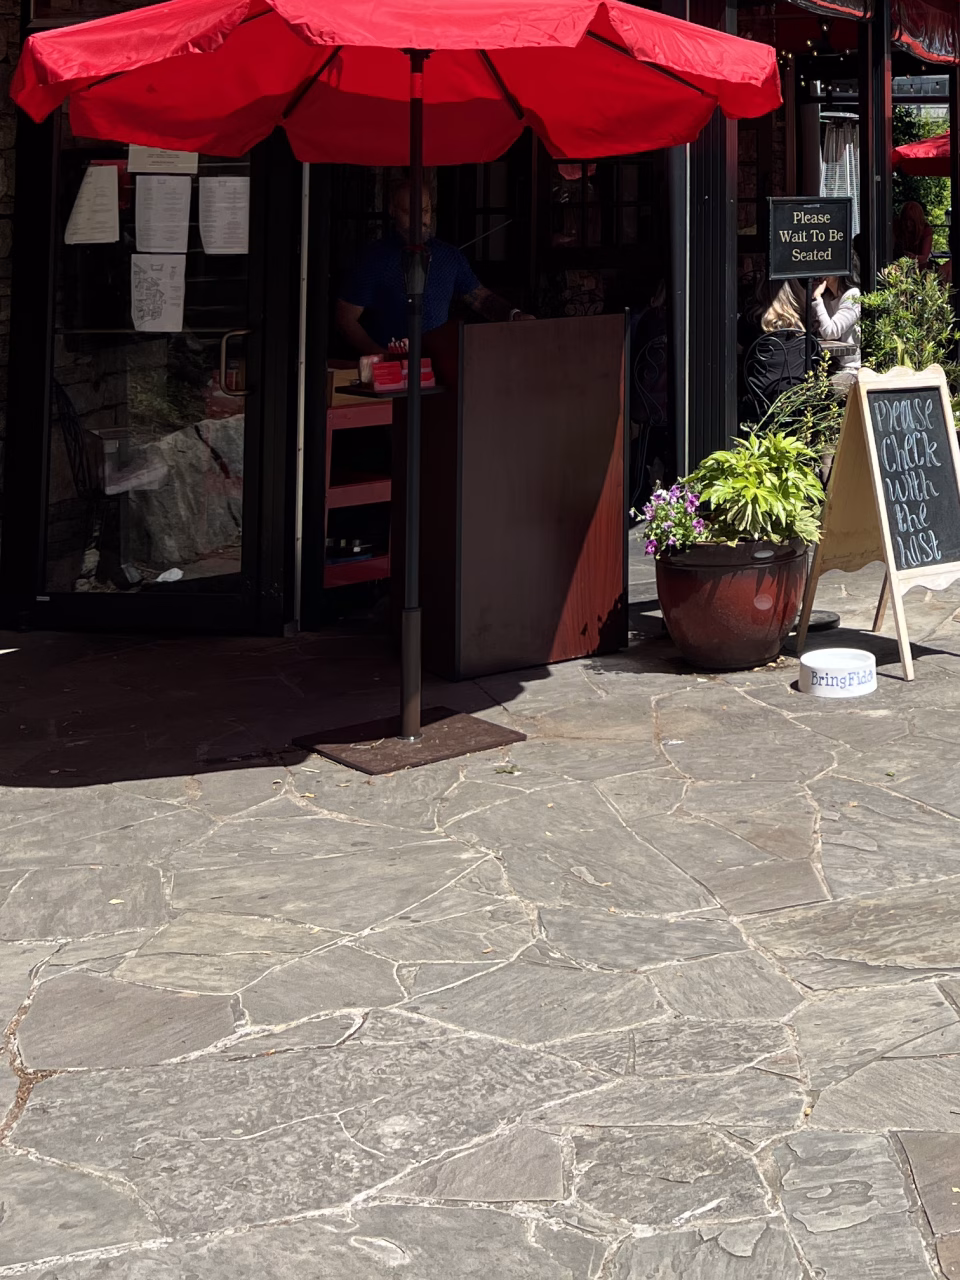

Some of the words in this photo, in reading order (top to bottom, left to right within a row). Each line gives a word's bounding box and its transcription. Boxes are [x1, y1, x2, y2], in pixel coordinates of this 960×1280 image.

[793, 211, 831, 224] Please
[779, 230, 808, 243] Wait
[810, 229, 826, 242] To
[829, 229, 844, 242] Be
[792, 247, 832, 261] Seated
[881, 431, 942, 472] Check
[885, 468, 940, 502] with
[894, 502, 930, 533] the
[897, 529, 942, 569] host
